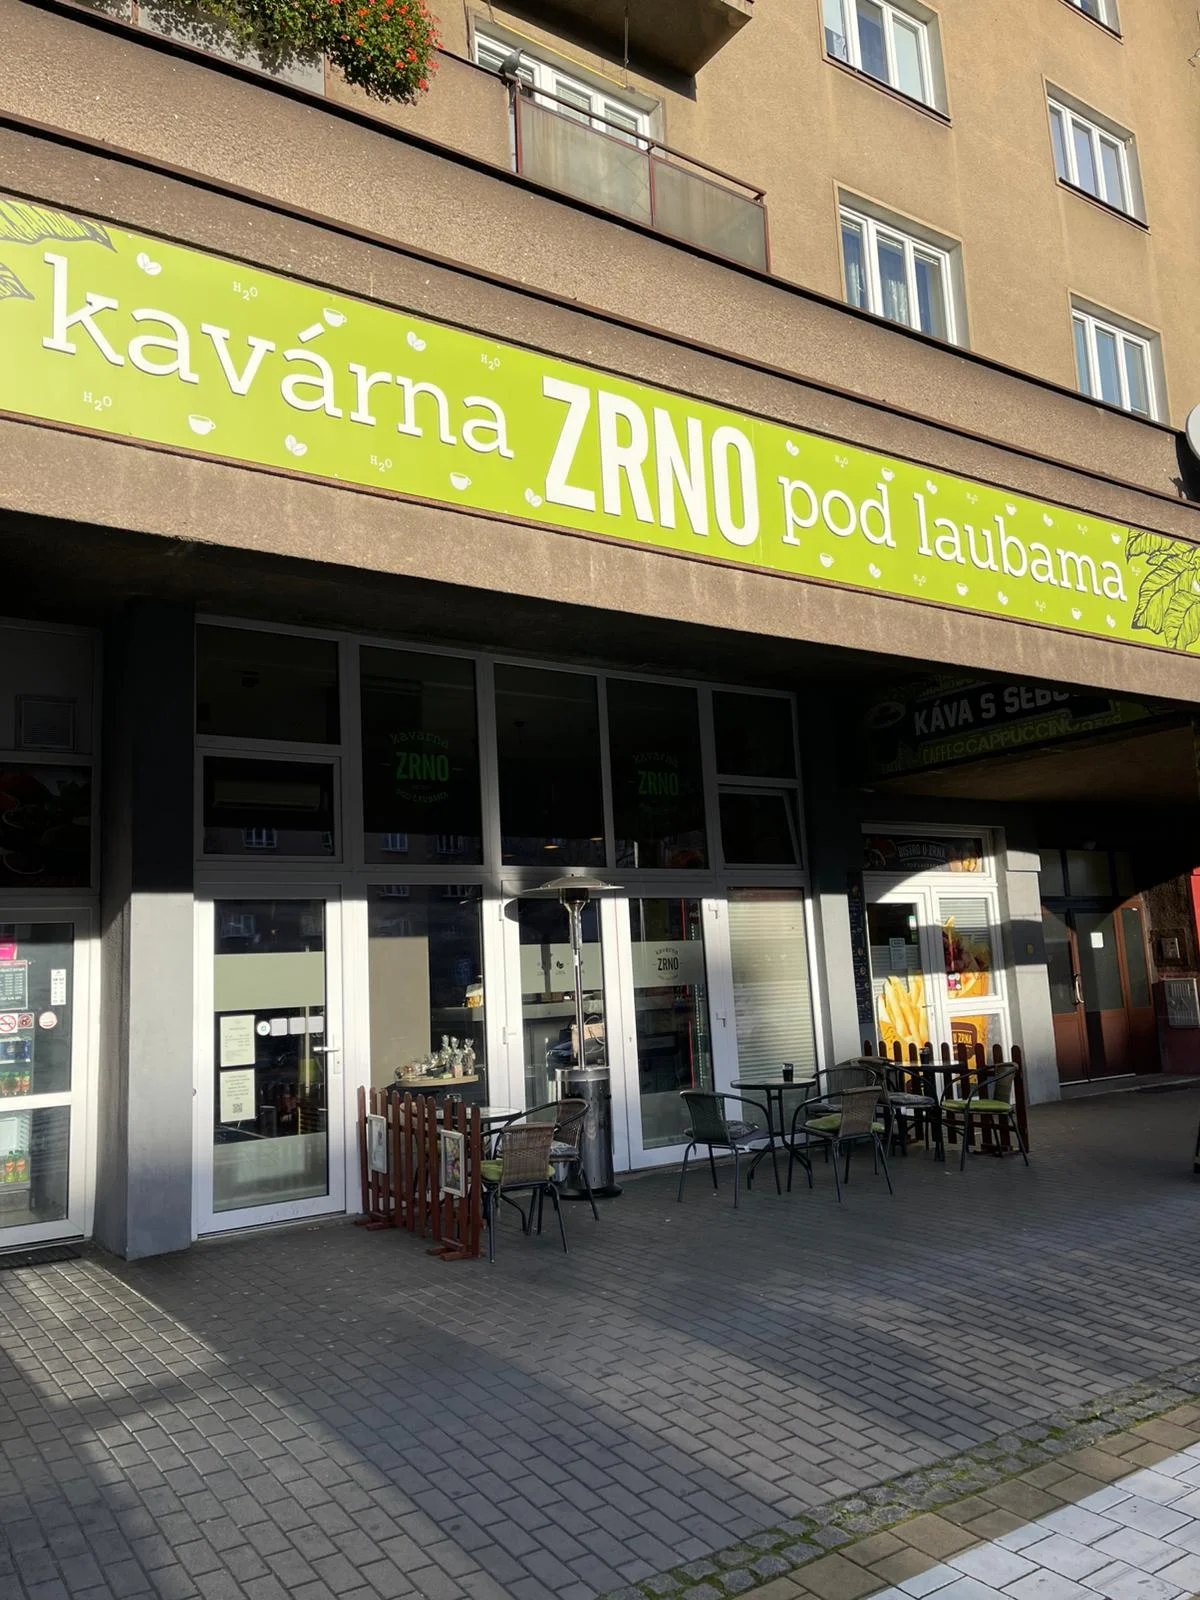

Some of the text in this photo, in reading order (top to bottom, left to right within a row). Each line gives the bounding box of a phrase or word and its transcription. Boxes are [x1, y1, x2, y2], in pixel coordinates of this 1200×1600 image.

[42, 252, 1128, 603] kavárna ZRNO pod laubama
[913, 698, 975, 736] KÁVA
[979, 692, 997, 719] S
[395, 751, 449, 782] ZRNO
[637, 770, 680, 796] ZRNO
[657, 956, 679, 971] ZRNO
